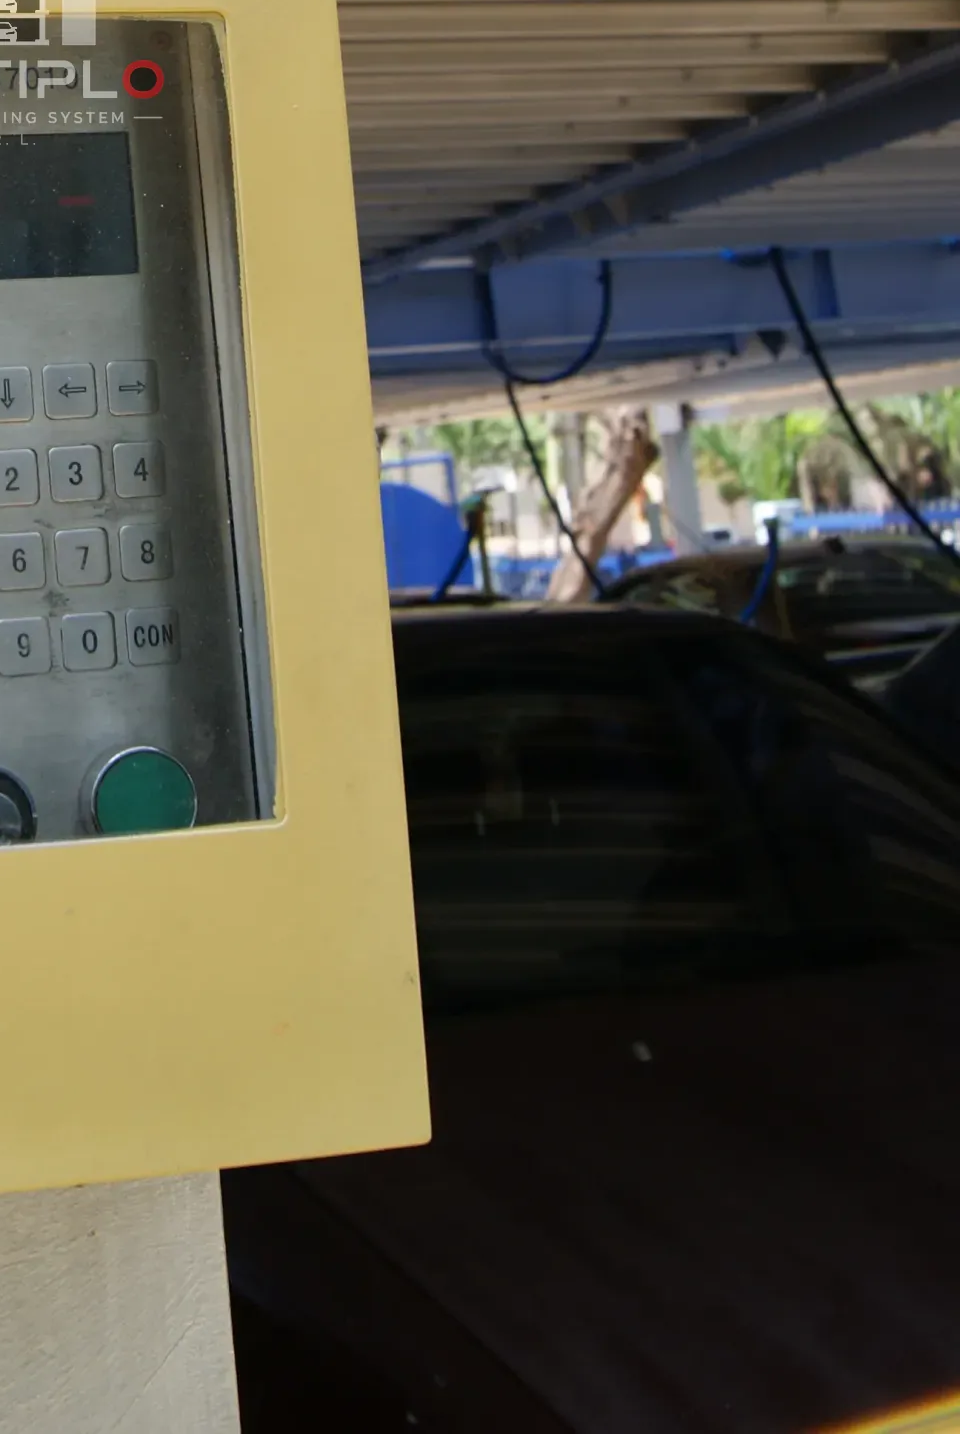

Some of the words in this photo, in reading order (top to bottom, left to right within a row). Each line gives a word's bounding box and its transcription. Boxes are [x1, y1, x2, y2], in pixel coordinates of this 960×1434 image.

[5, 467, 20, 491] 2
[68, 462, 83, 486] 3
[133, 457, 149, 482] 4
[12, 548, 27, 573] 6
[75, 546, 90, 570] 7
[140, 540, 155, 564] 8
[17, 633, 31, 657] 9
[82, 629, 98, 654] 0
[133, 624, 174, 649] CON
